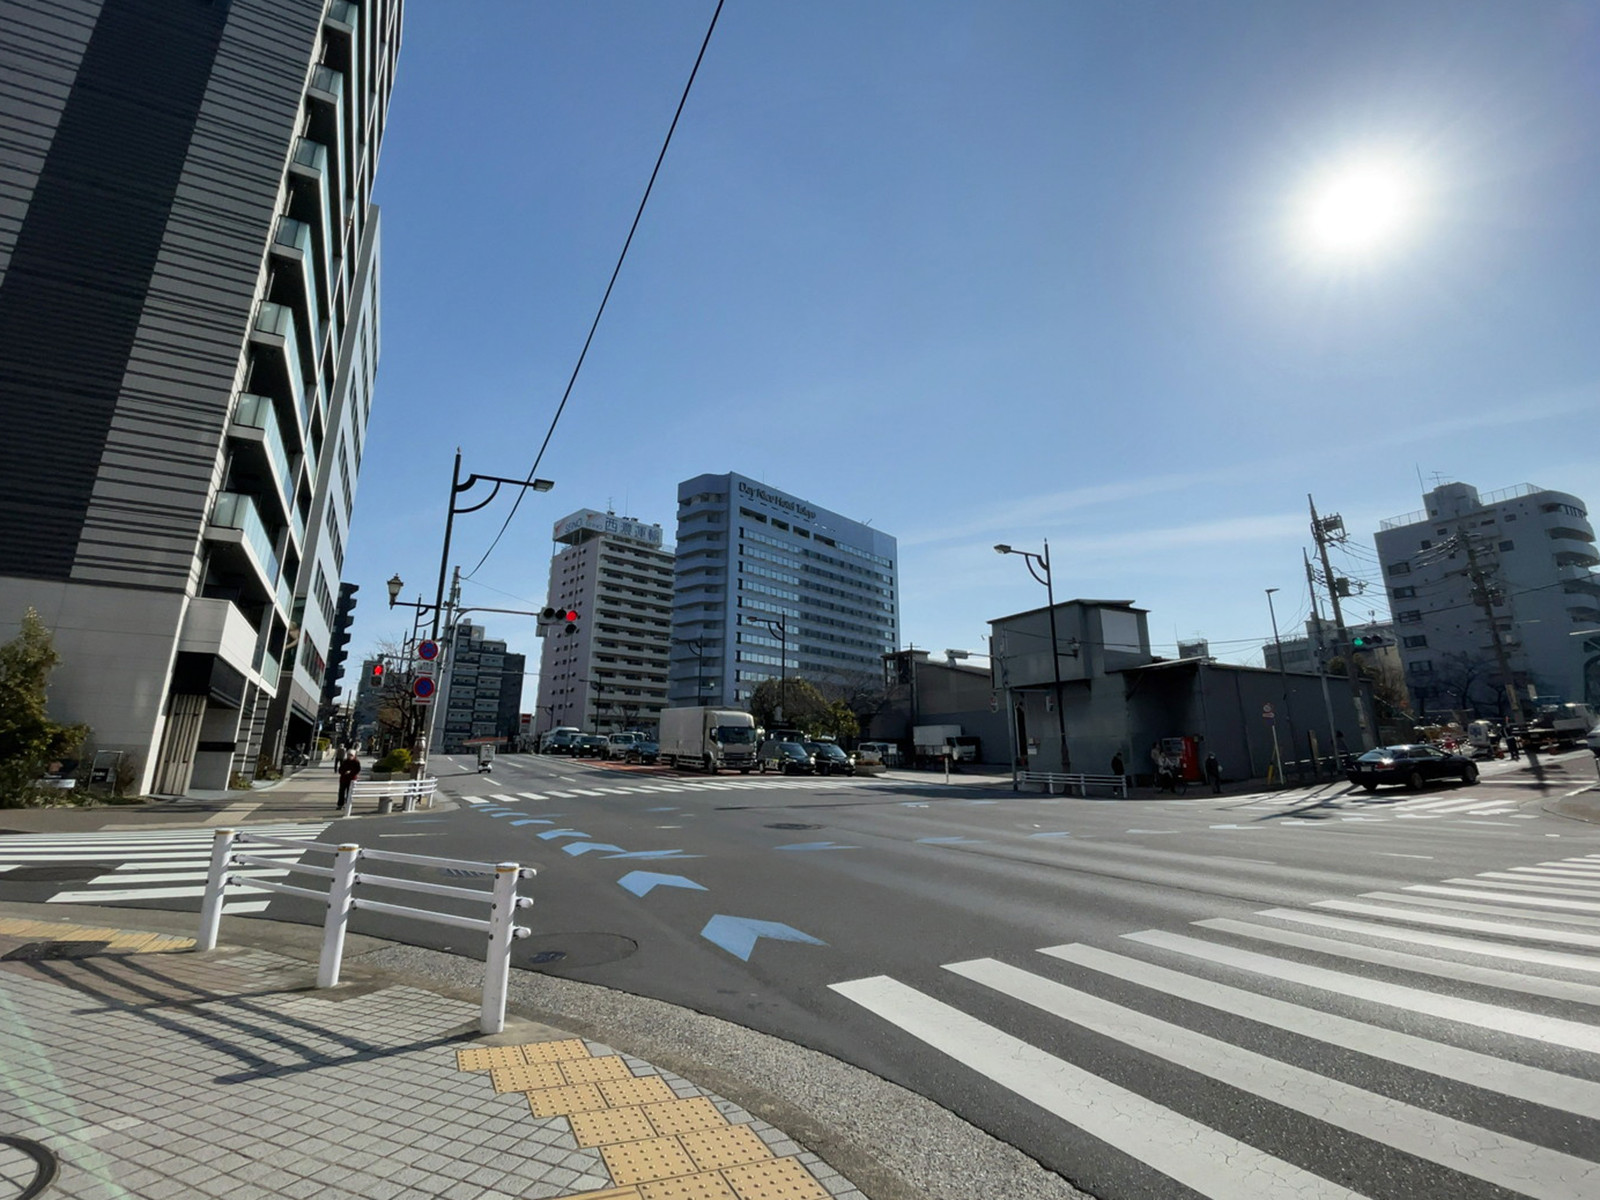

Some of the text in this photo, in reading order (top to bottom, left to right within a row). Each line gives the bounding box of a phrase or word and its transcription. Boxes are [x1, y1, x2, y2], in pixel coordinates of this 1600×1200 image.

[738, 481, 817, 519] Day Nice Hotel Tokyo
